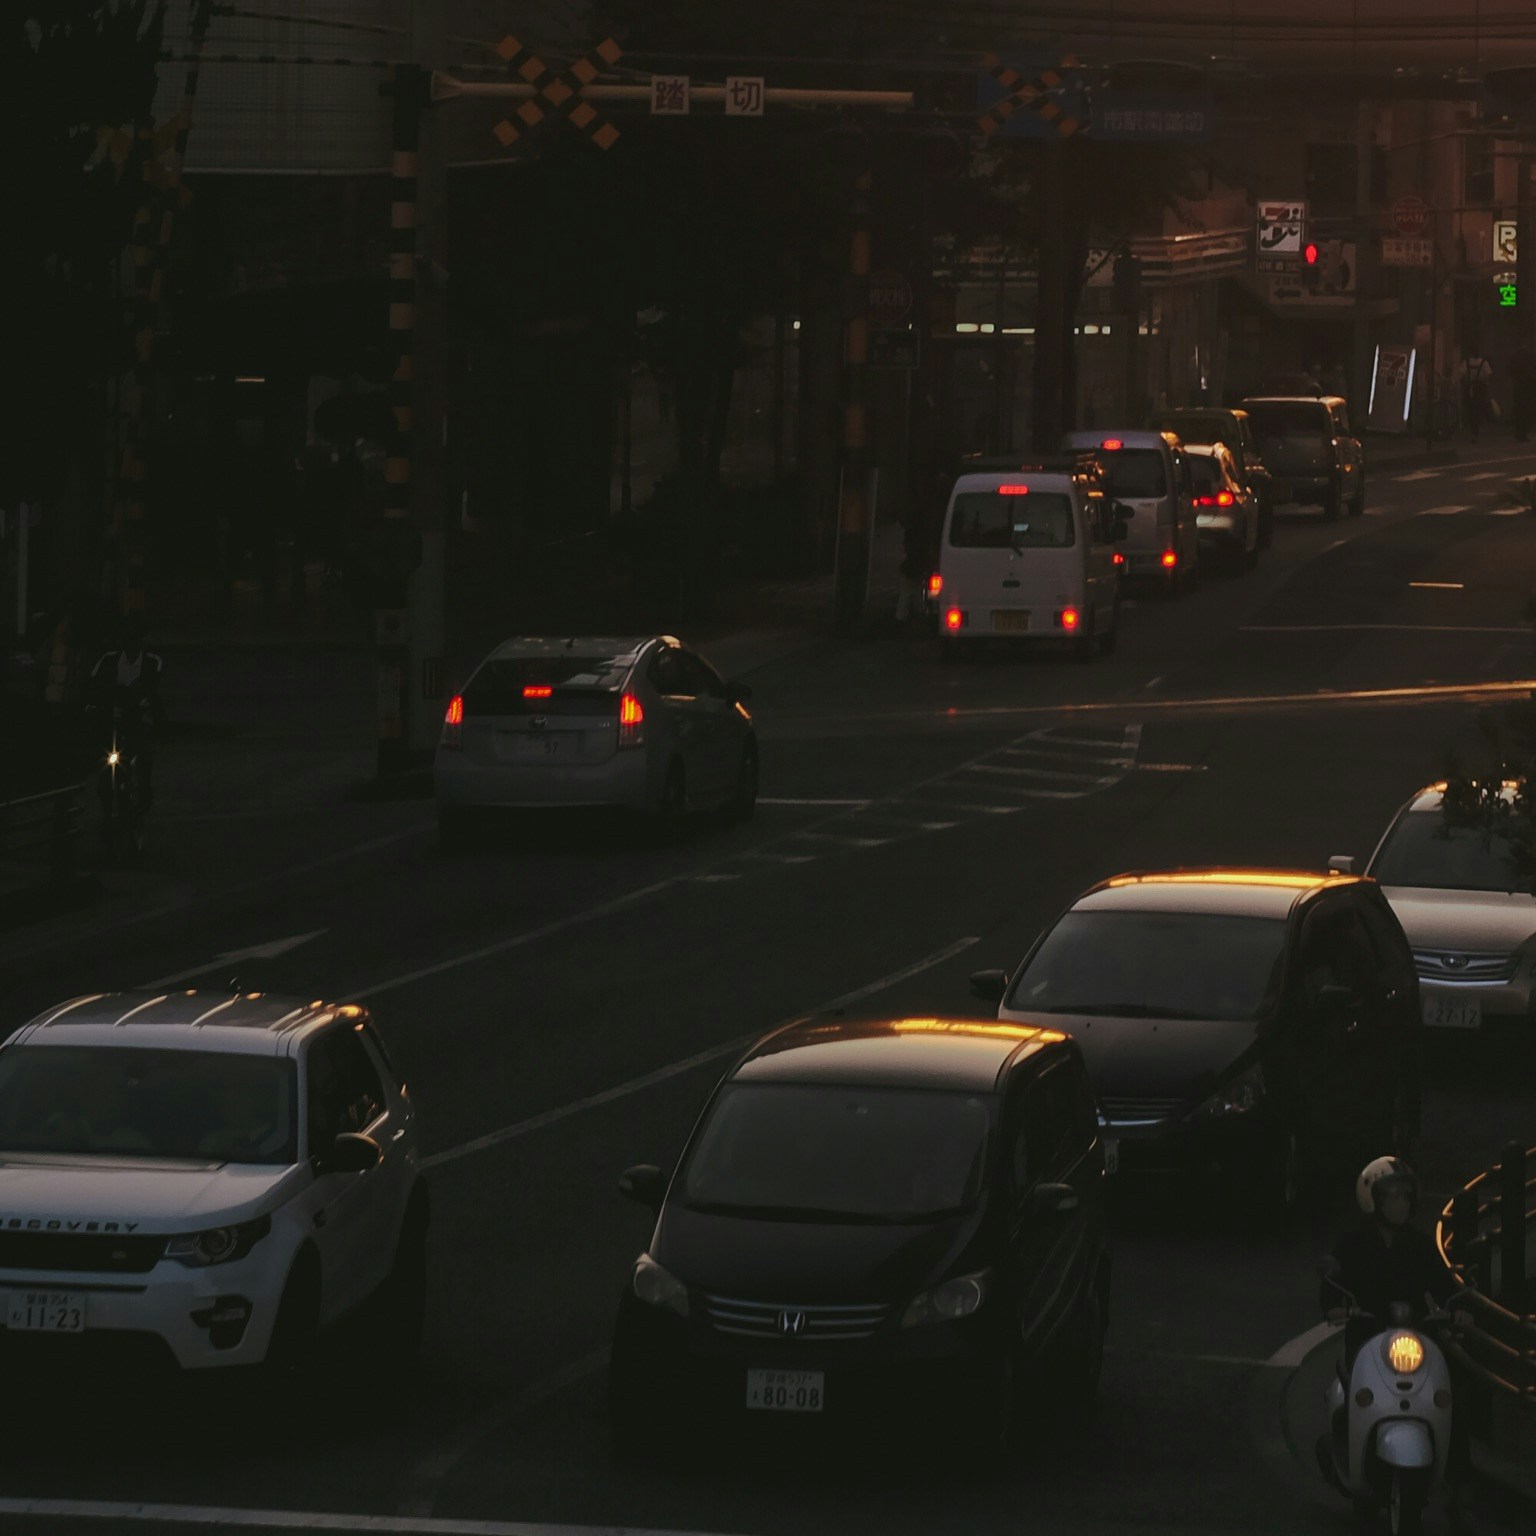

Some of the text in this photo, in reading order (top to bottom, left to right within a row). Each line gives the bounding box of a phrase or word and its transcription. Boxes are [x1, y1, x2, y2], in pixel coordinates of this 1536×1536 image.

[656, 79, 760, 112] 踏切
[27, 1307, 81, 1329] 11-23
[763, 1385, 820, 1408] 80-08
